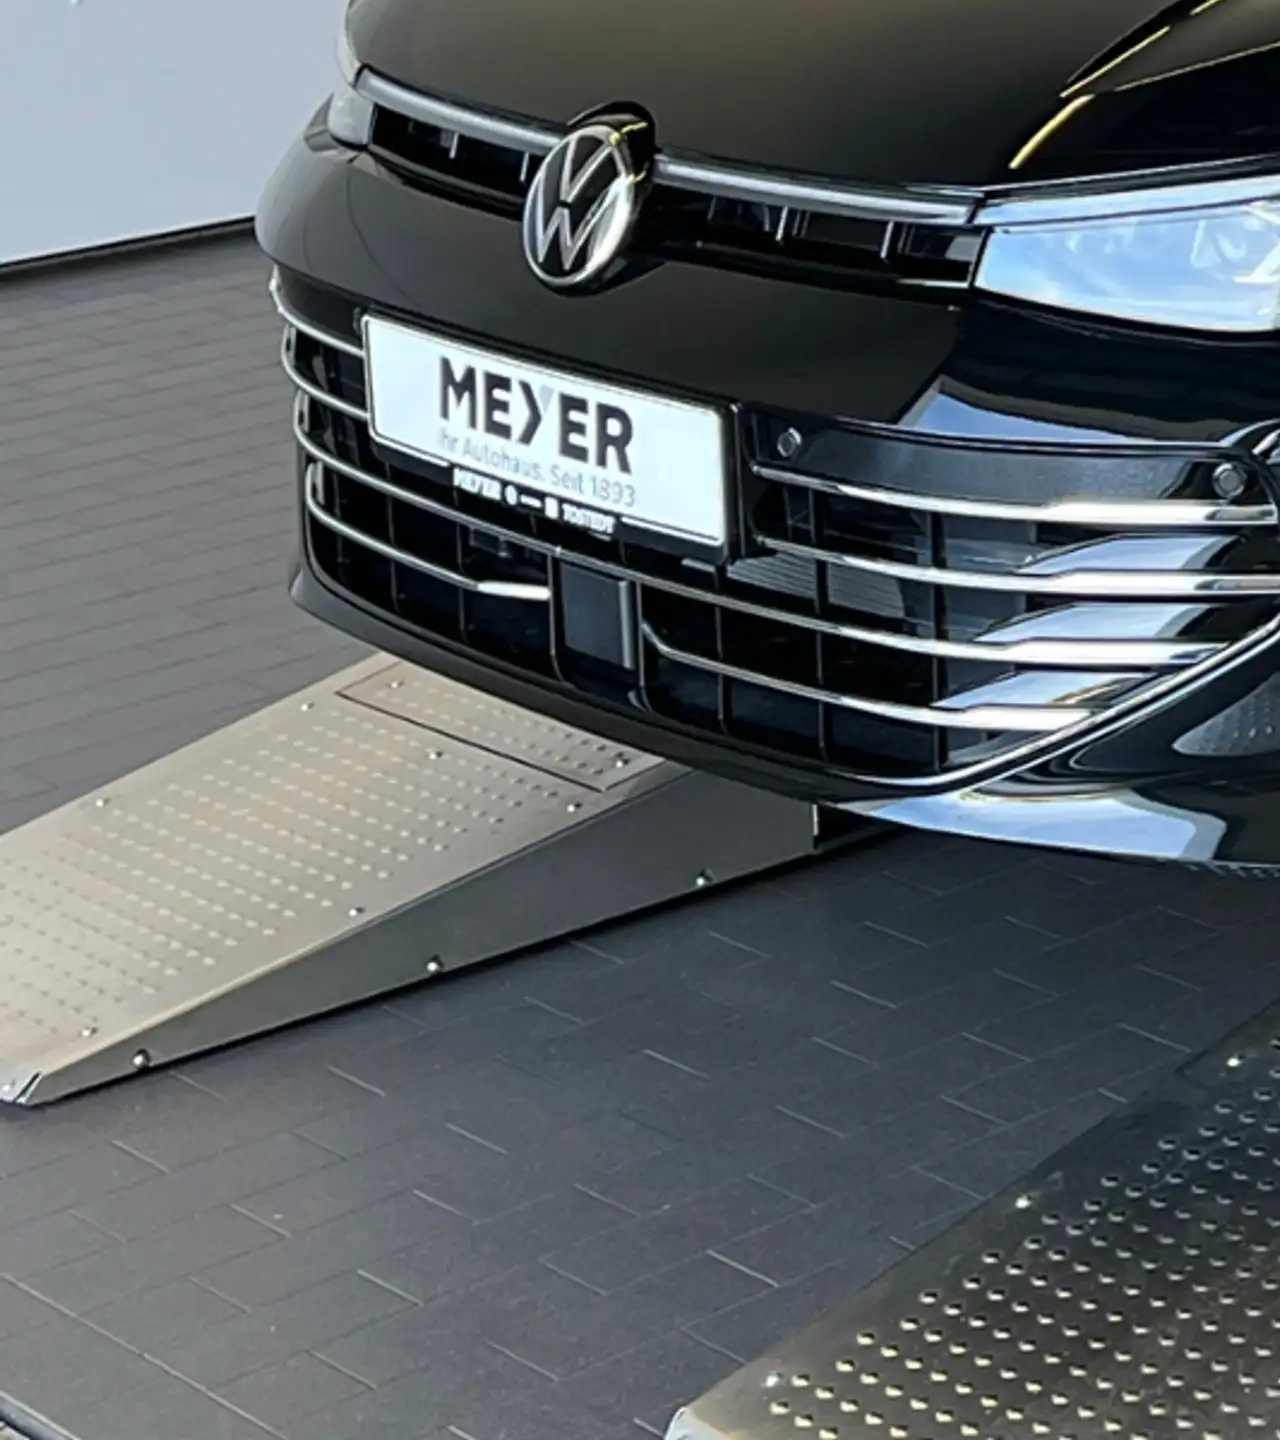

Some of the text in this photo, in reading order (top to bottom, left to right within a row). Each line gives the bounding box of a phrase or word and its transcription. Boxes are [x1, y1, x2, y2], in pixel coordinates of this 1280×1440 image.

[439, 356, 634, 475] MEYER
[462, 437, 546, 483] Autohaus.
[549, 463, 584, 496] Seit
[591, 476, 637, 509] 1893
